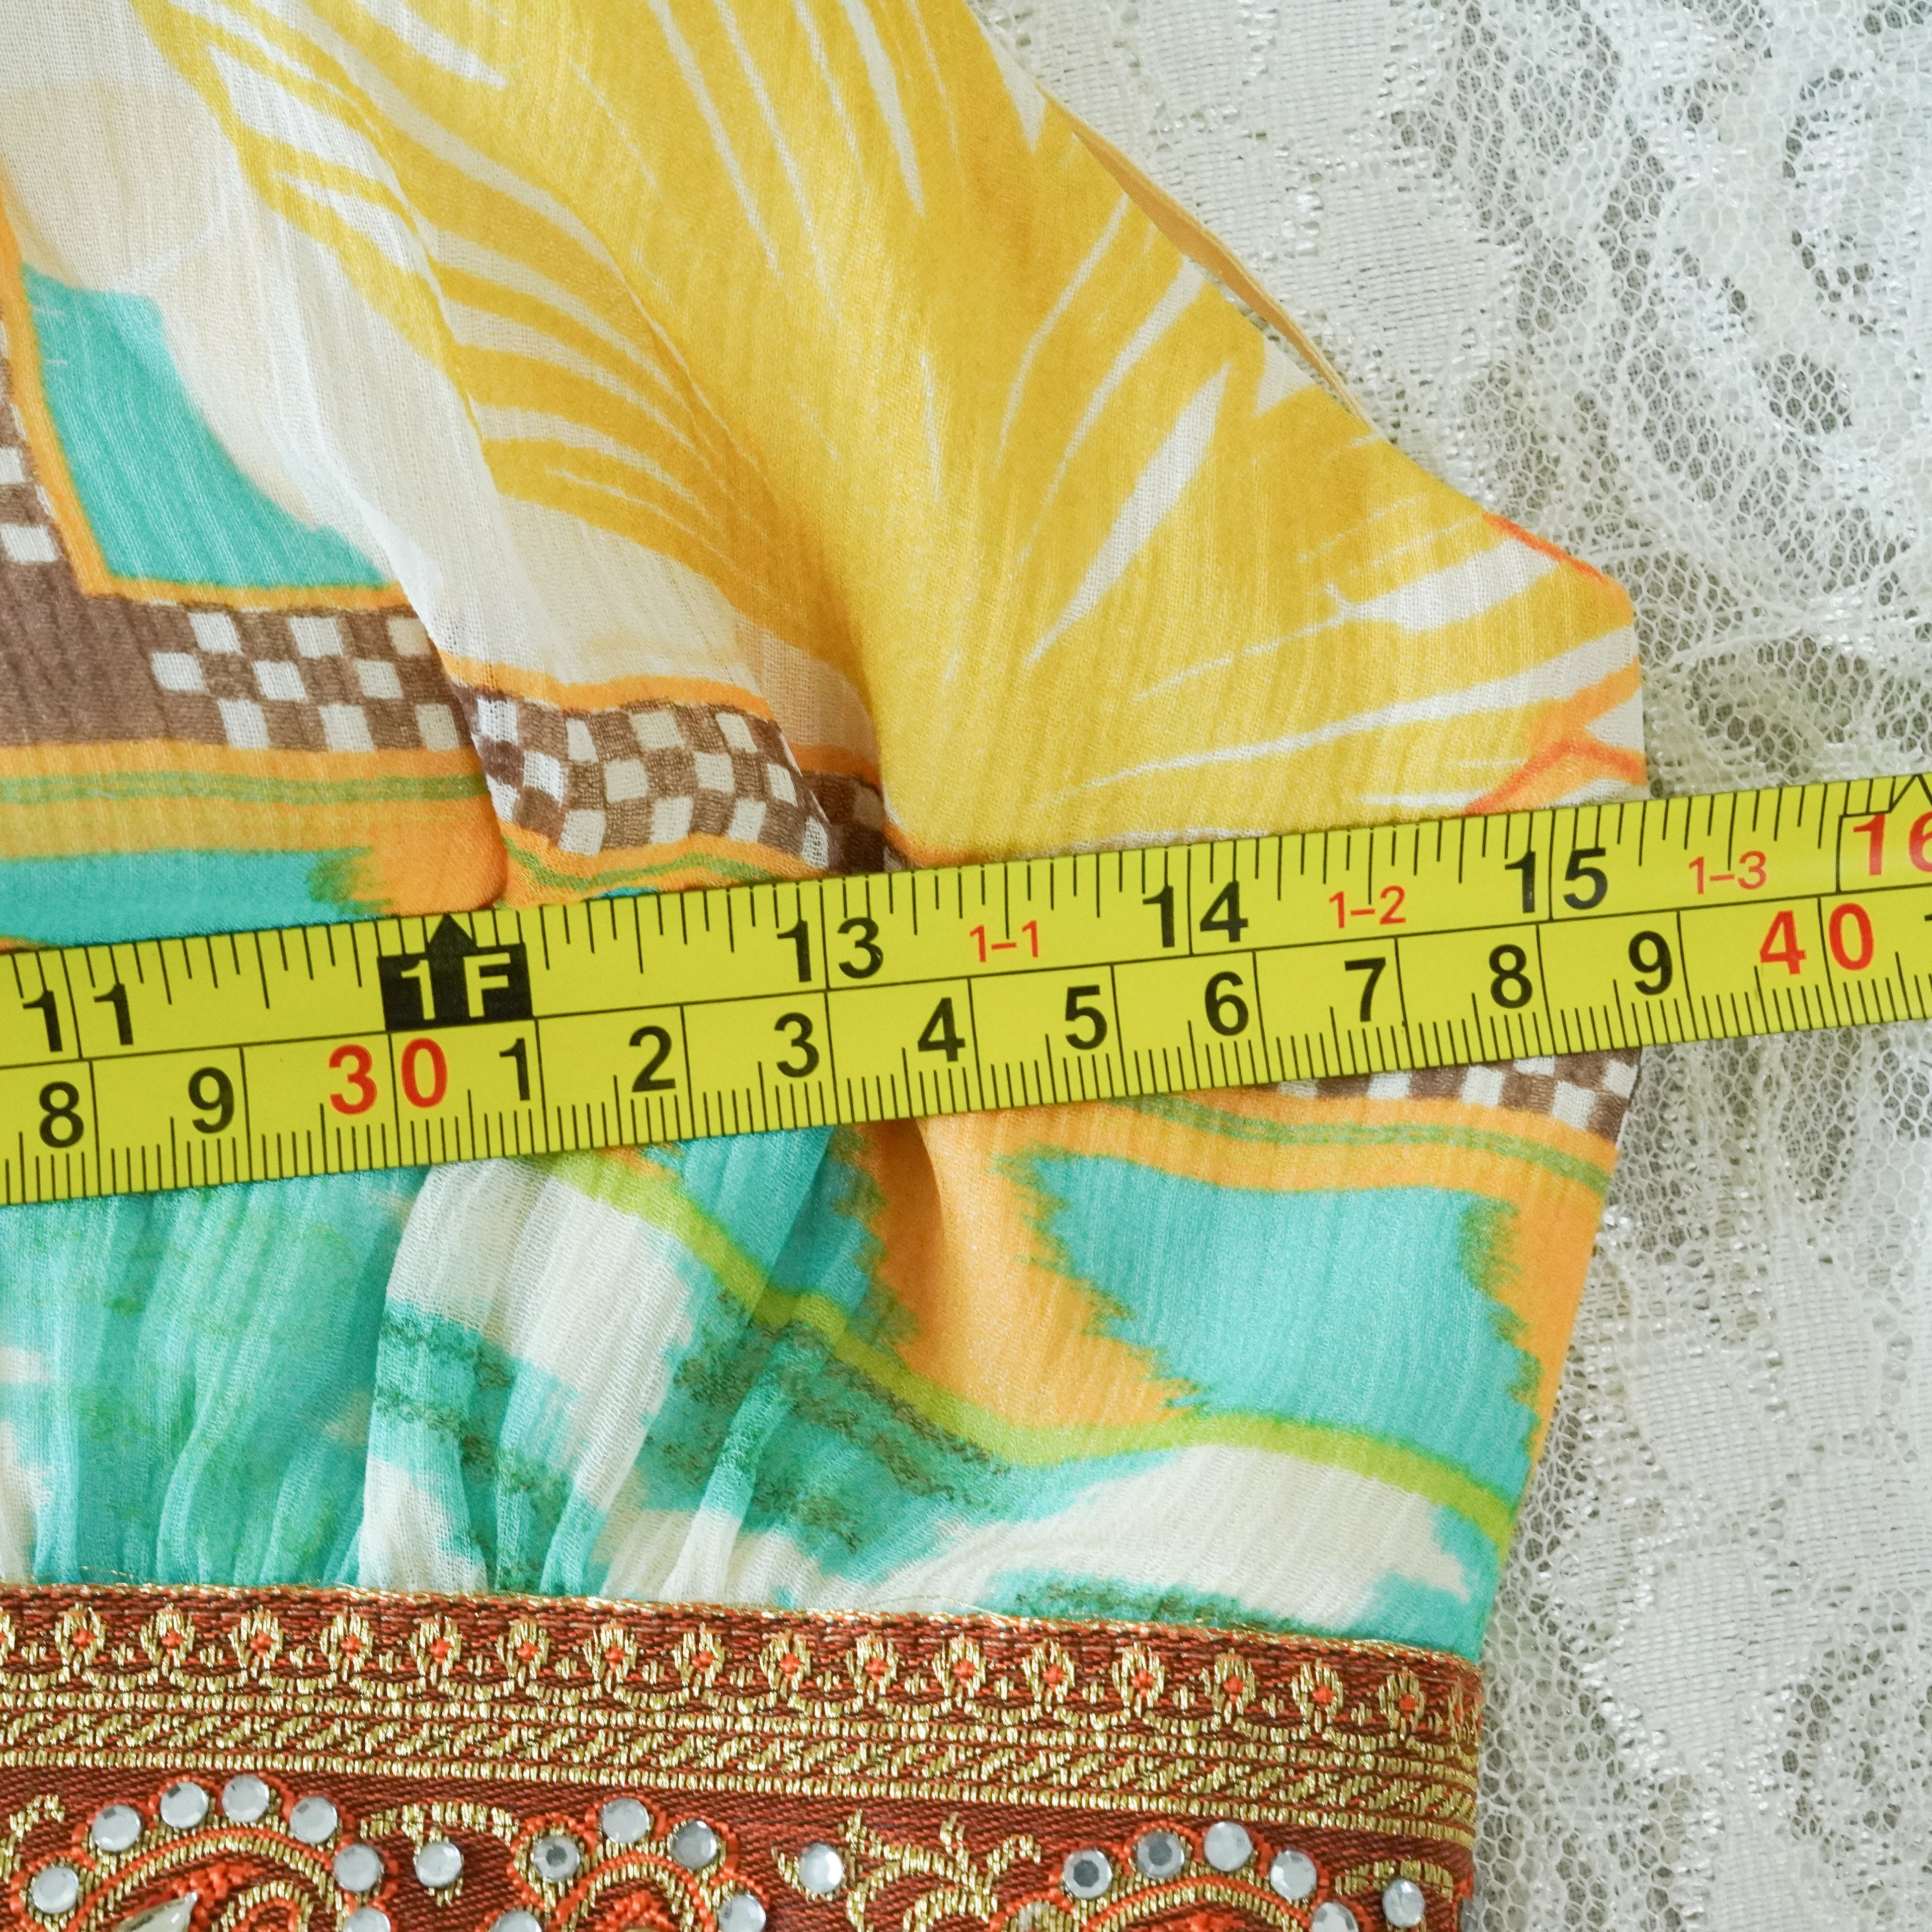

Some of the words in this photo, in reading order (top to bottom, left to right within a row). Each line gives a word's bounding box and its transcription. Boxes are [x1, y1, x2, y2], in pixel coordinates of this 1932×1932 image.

[23, 983, 133, 1052] 11
[401, 952, 511, 1021] 1F
[777, 917, 883, 983] 13
[969, 920, 1038, 962] 1-1
[1143, 880, 1249, 948] 14
[1329, 886, 1406, 929] 1-2
[1505, 847, 1608, 913] 15
[1688, 850, 1767, 895] 1-3
[39, 1081, 84, 1148] 8
[188, 1067, 234, 1134] 9
[329, 1037, 448, 1114] 30
[499, 1037, 530, 1101] 1
[628, 1026, 676, 1093] 2
[774, 1012, 820, 1078] 3
[917, 997, 966, 1063] 4
[1064, 985, 1107, 1050] 5
[1206, 972, 1249, 1036] 6
[1344, 956, 1387, 1022] 7
[1488, 944, 1533, 1008] 8
[1629, 930, 1673, 995] 9
[1759, 903, 1875, 976] 40
